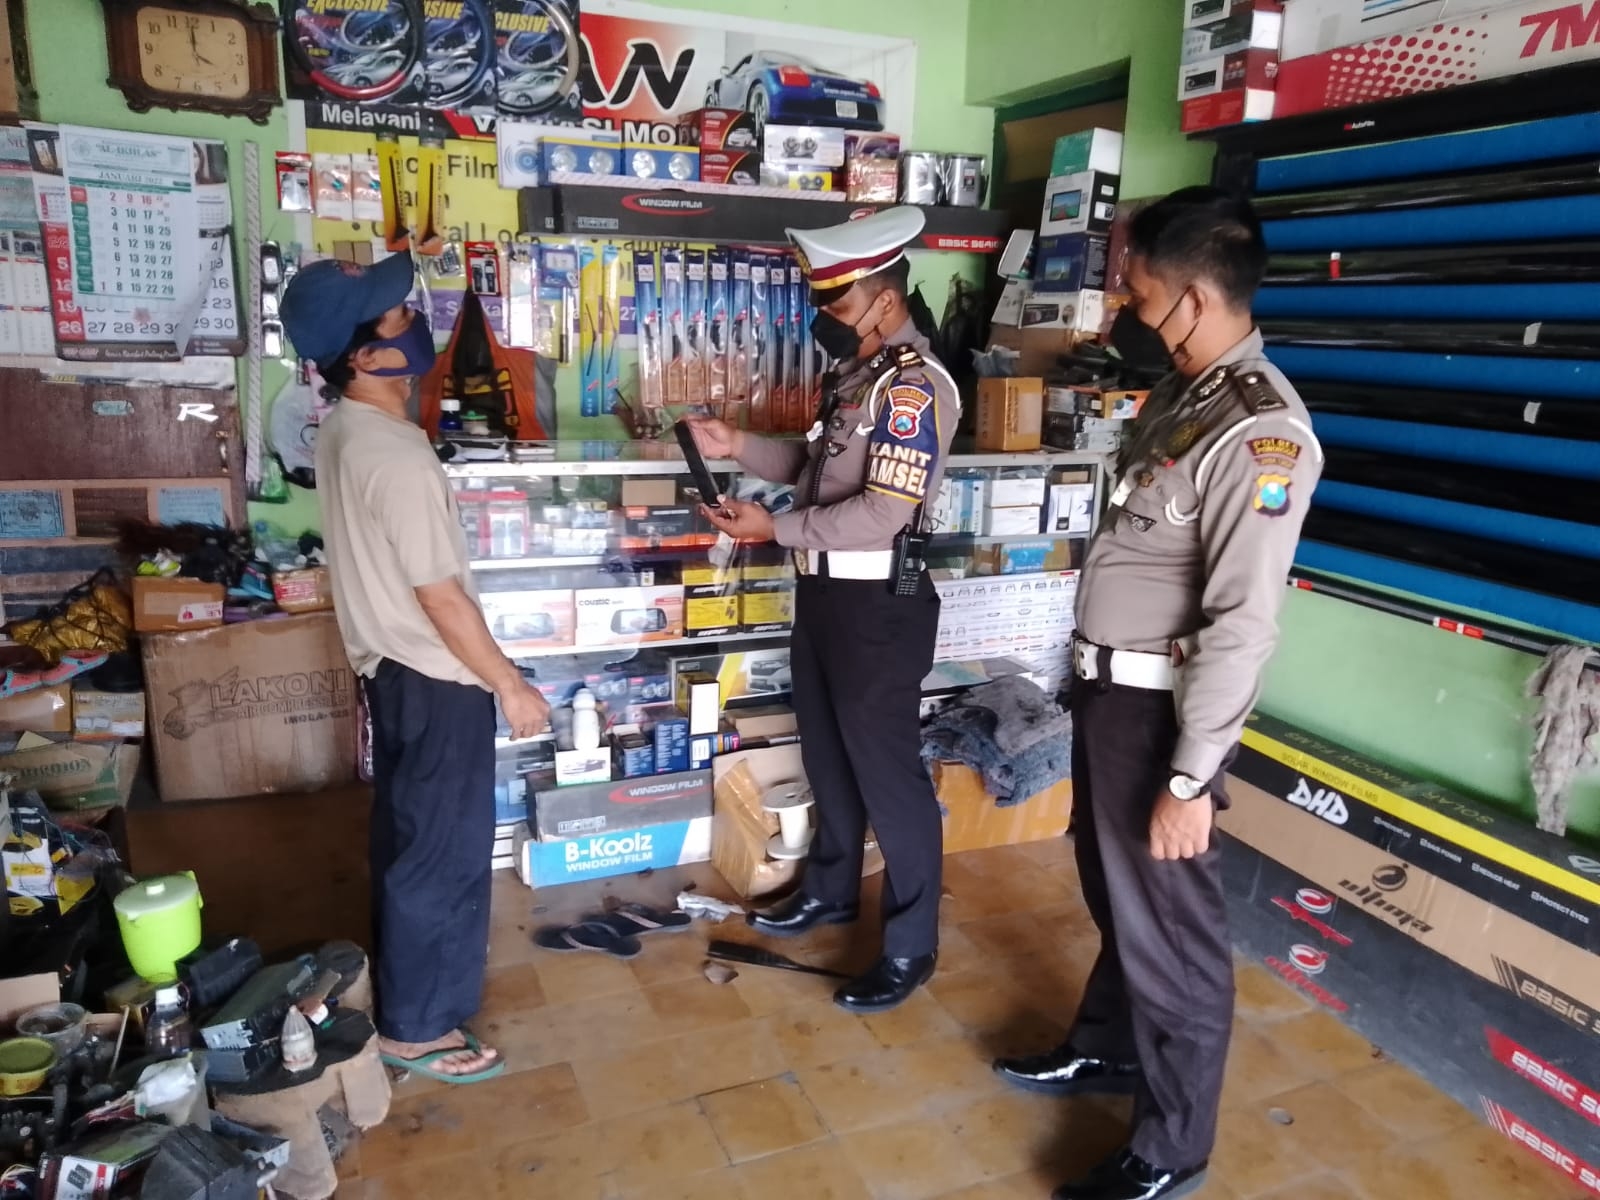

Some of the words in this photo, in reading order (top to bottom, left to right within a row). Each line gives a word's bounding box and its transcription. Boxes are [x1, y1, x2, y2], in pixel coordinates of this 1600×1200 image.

[322, 103, 420, 131] Melavani
[639, 198, 679, 210] WINDOW
[58, 321, 82, 335] 26
[88, 321, 106, 334] 27
[113, 321, 135, 335] 28
[140, 321, 160, 335] 29
[176, 402, 220, 423] R
[868, 442, 932, 468] KANIT
[210, 666, 348, 709] LAKONI
[628, 782, 676, 797] WINDOW
[678, 778, 704, 789] FILM
[1286, 776, 1350, 825] DHD
[564, 831, 653, 863] B-Koolz
[565, 857, 622, 872] WINDOW
[623, 851, 653, 864] FILM
[1520, 979, 1589, 1027] BASIC
[1511, 1050, 1577, 1101] BASIC
[1510, 1121, 1576, 1174] BASIC
